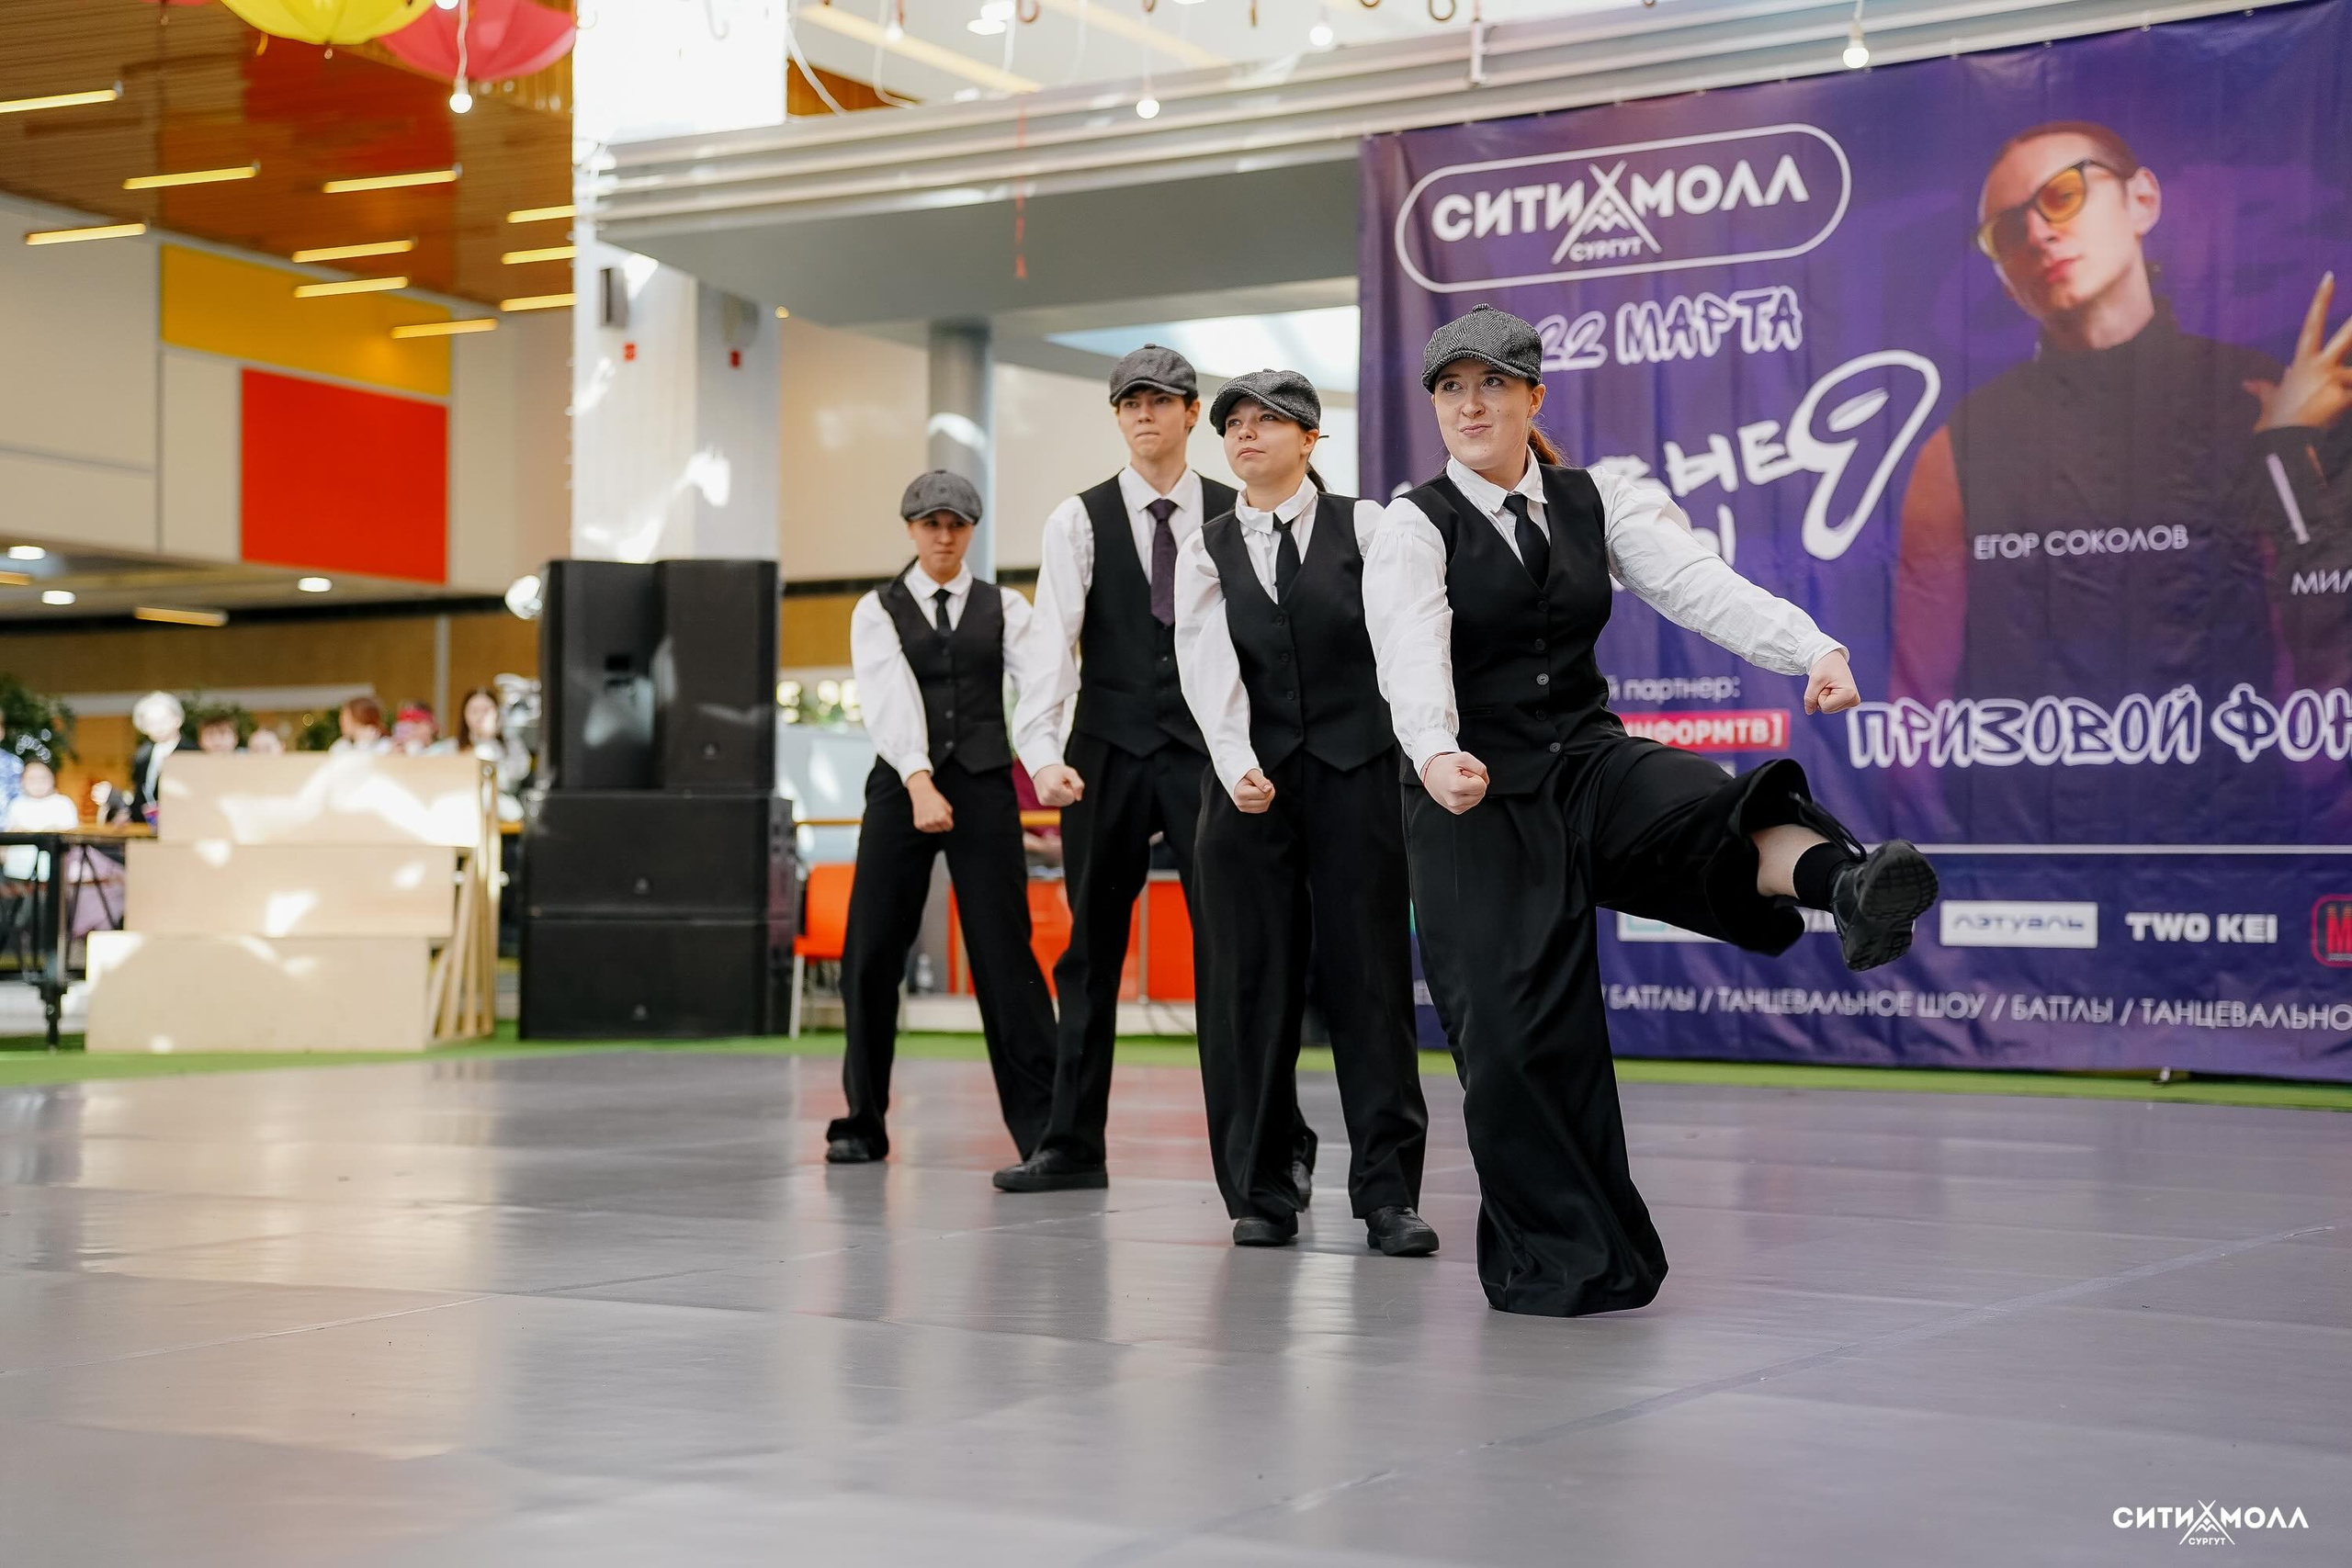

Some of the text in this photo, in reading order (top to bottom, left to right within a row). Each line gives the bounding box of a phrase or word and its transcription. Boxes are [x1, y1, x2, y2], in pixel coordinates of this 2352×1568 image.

[1568, 235, 1643, 263] СУРГУТ
[1614, 285, 1804, 366] МАРТА
[1973, 524, 2190, 560] ЕГОР СОКОЛОВ
[1623, 676, 1741, 704] партнер:
[1846, 683, 2203, 769] ПРИЗОВОЙ
[2124, 912, 2278, 944] TWO KEI
[1716, 985, 1915, 1019] ТАНЦЕВАЛЬНОЕ
[1917, 991, 1986, 1020] ШОУ
[2010, 994, 2114, 1023] БАТТЛЫ
